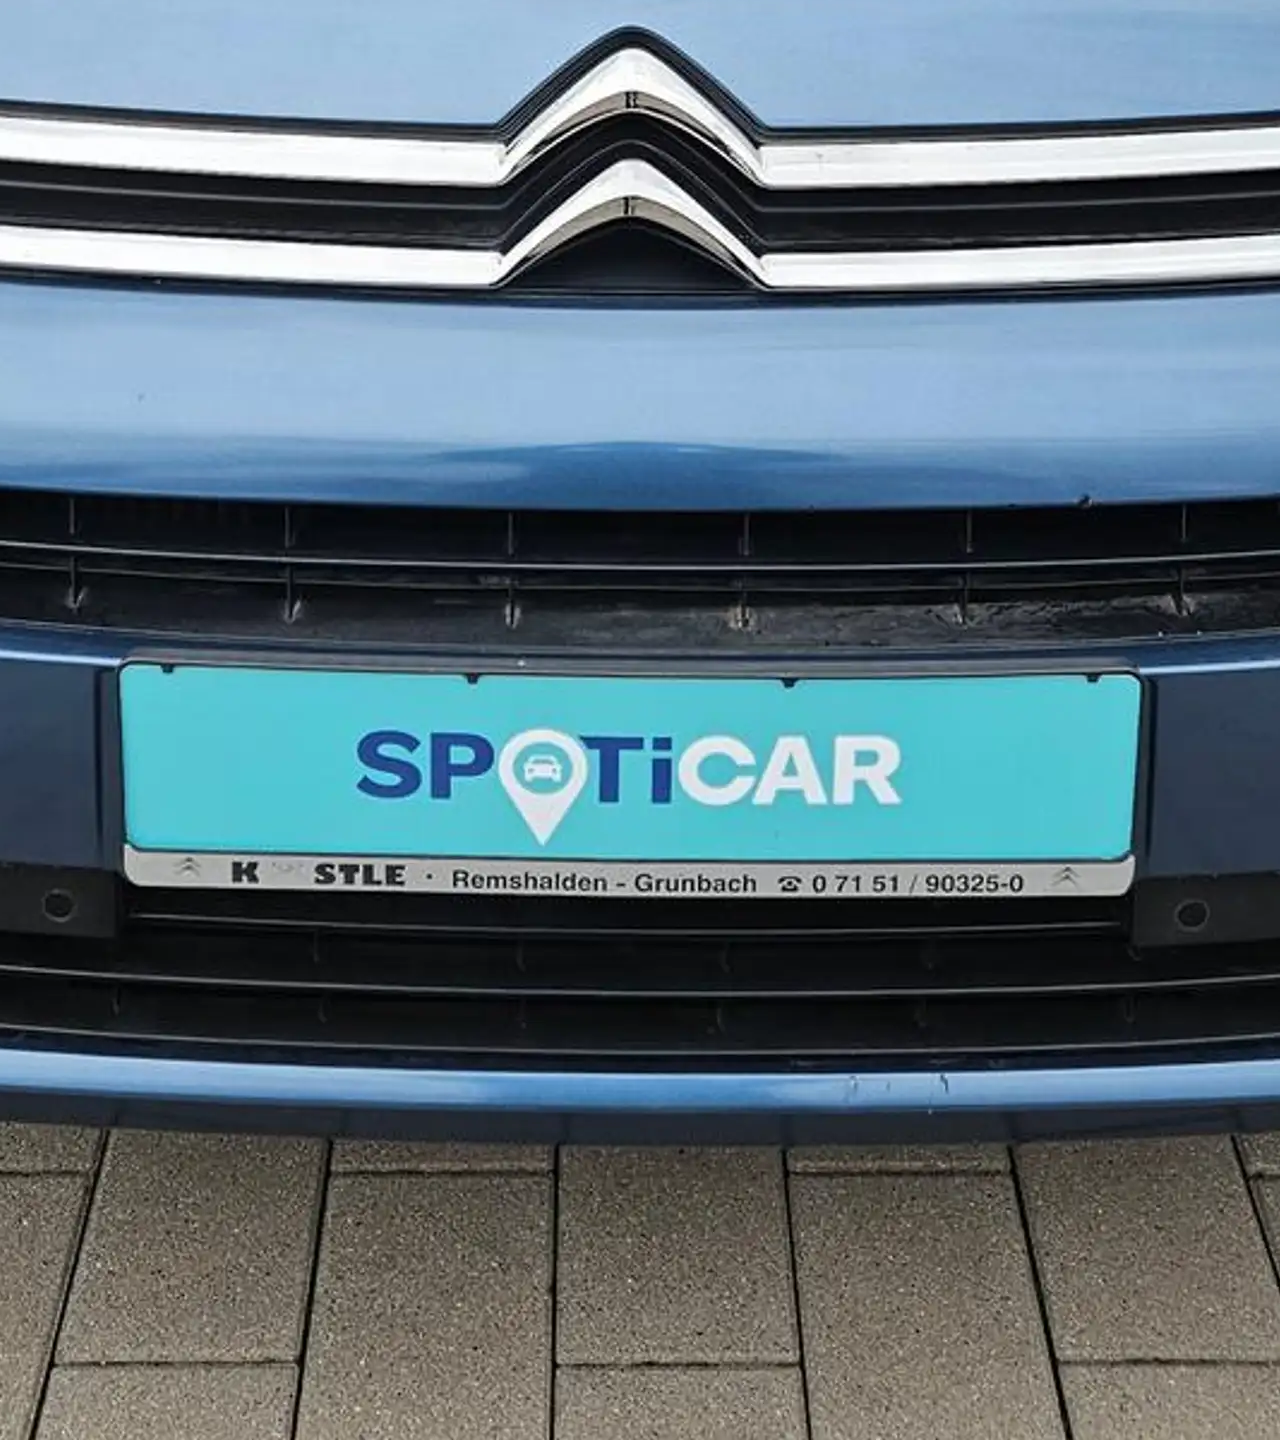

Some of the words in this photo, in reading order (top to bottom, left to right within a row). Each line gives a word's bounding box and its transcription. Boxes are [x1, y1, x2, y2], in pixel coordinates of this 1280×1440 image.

[452, 870, 608, 891] Remshalden
[634, 873, 757, 893] Grunbach
[812, 875, 826, 893] 0
[835, 875, 861, 893] 71
[872, 875, 899, 893] 51
[925, 874, 1024, 893] 90325-0
